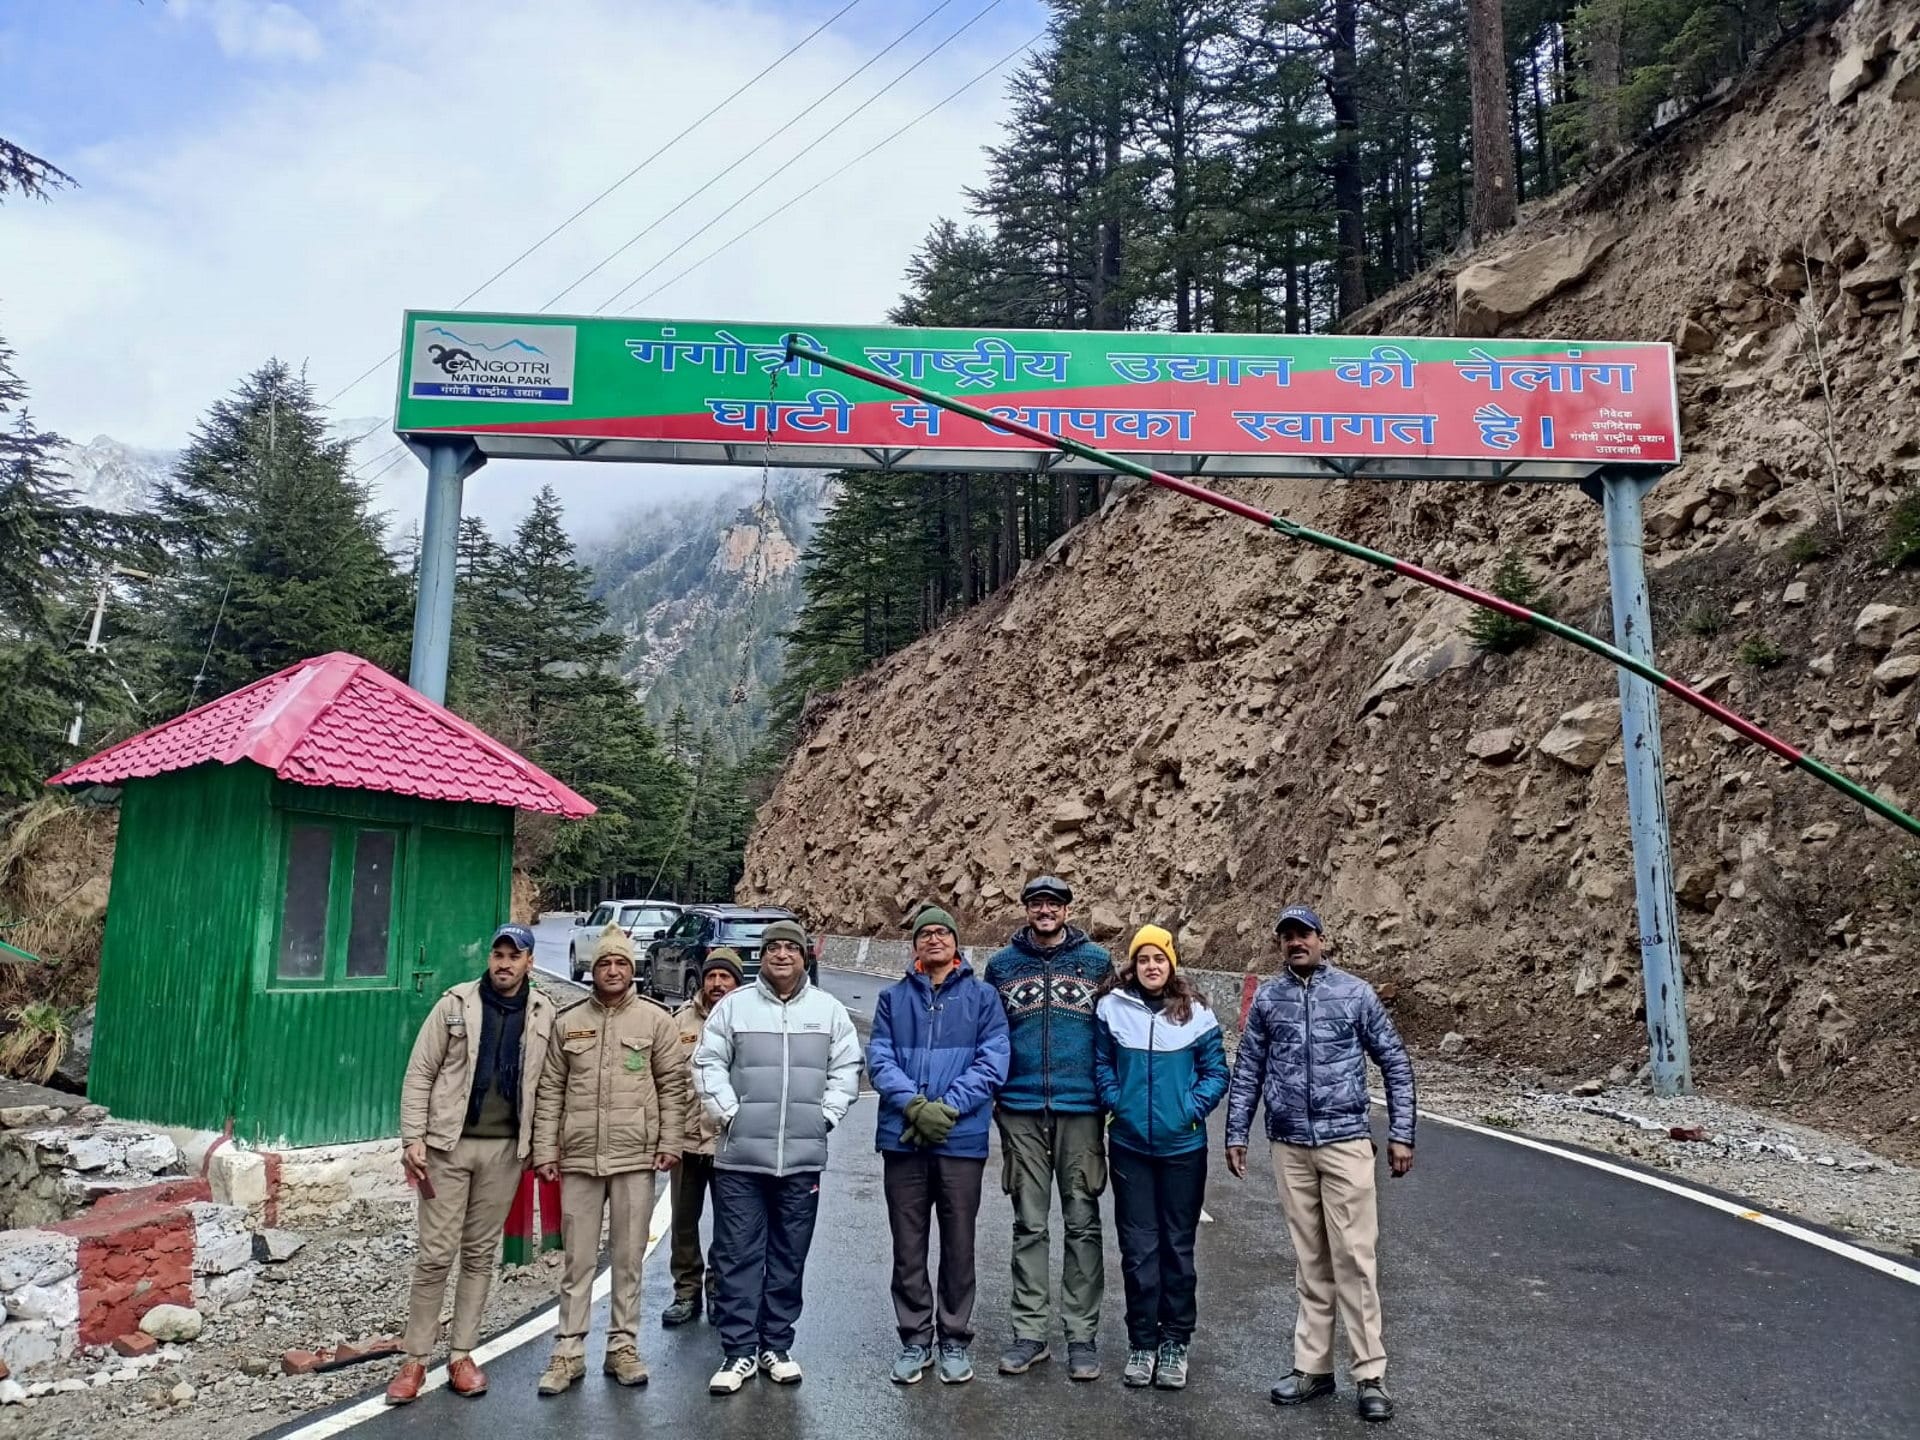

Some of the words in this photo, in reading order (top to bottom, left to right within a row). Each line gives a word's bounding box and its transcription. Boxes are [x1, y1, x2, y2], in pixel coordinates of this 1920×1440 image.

[447, 358, 550, 374] GANGOTRI
[626, 328, 828, 376] गंगोत्री
[864, 337, 1071, 388] राष्ट्रीय
[1106, 351, 1294, 387] उद्यान
[1329, 346, 1417, 388] की
[1453, 347, 1637, 394] नेलांग
[451, 373, 515, 385] NATIONAL
[517, 375, 552, 386] PARK
[441, 385, 471, 395] गंगोत्री
[476, 386, 508, 398] राष्ट्रीय
[513, 389, 543, 398] उद्यान
[704, 388, 855, 434] घाटी
[982, 406, 1197, 441] आपका
[1232, 410, 1438, 445] स्वागत
[1599, 407, 1633, 419] निवेदक
